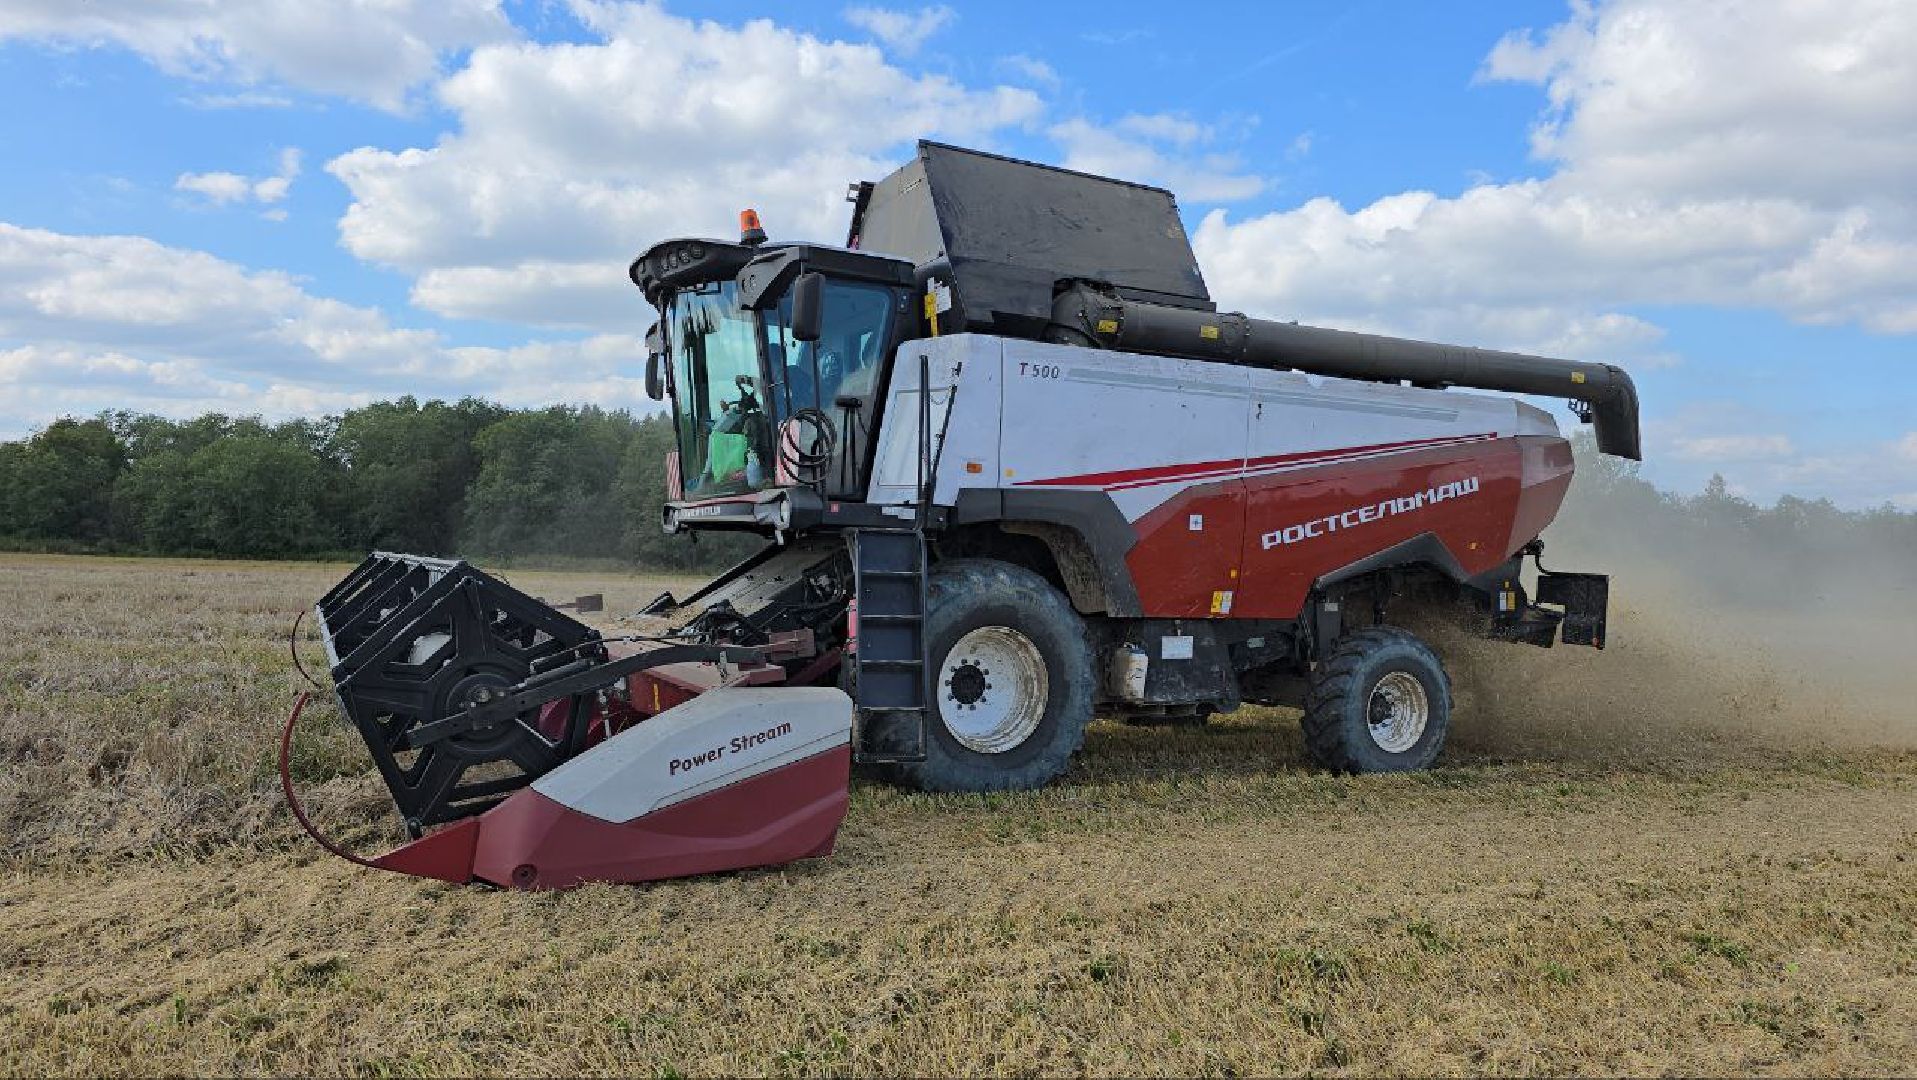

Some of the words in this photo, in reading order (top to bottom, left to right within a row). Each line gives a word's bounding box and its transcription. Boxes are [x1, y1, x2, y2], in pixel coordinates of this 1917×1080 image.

[1019, 362, 1028, 376] T
[1032, 364, 1060, 379] 500
[1261, 476, 1479, 550] РОСТСЕЛЬМАШ
[669, 745, 726, 776] Power
[730, 722, 791, 753] Stream
